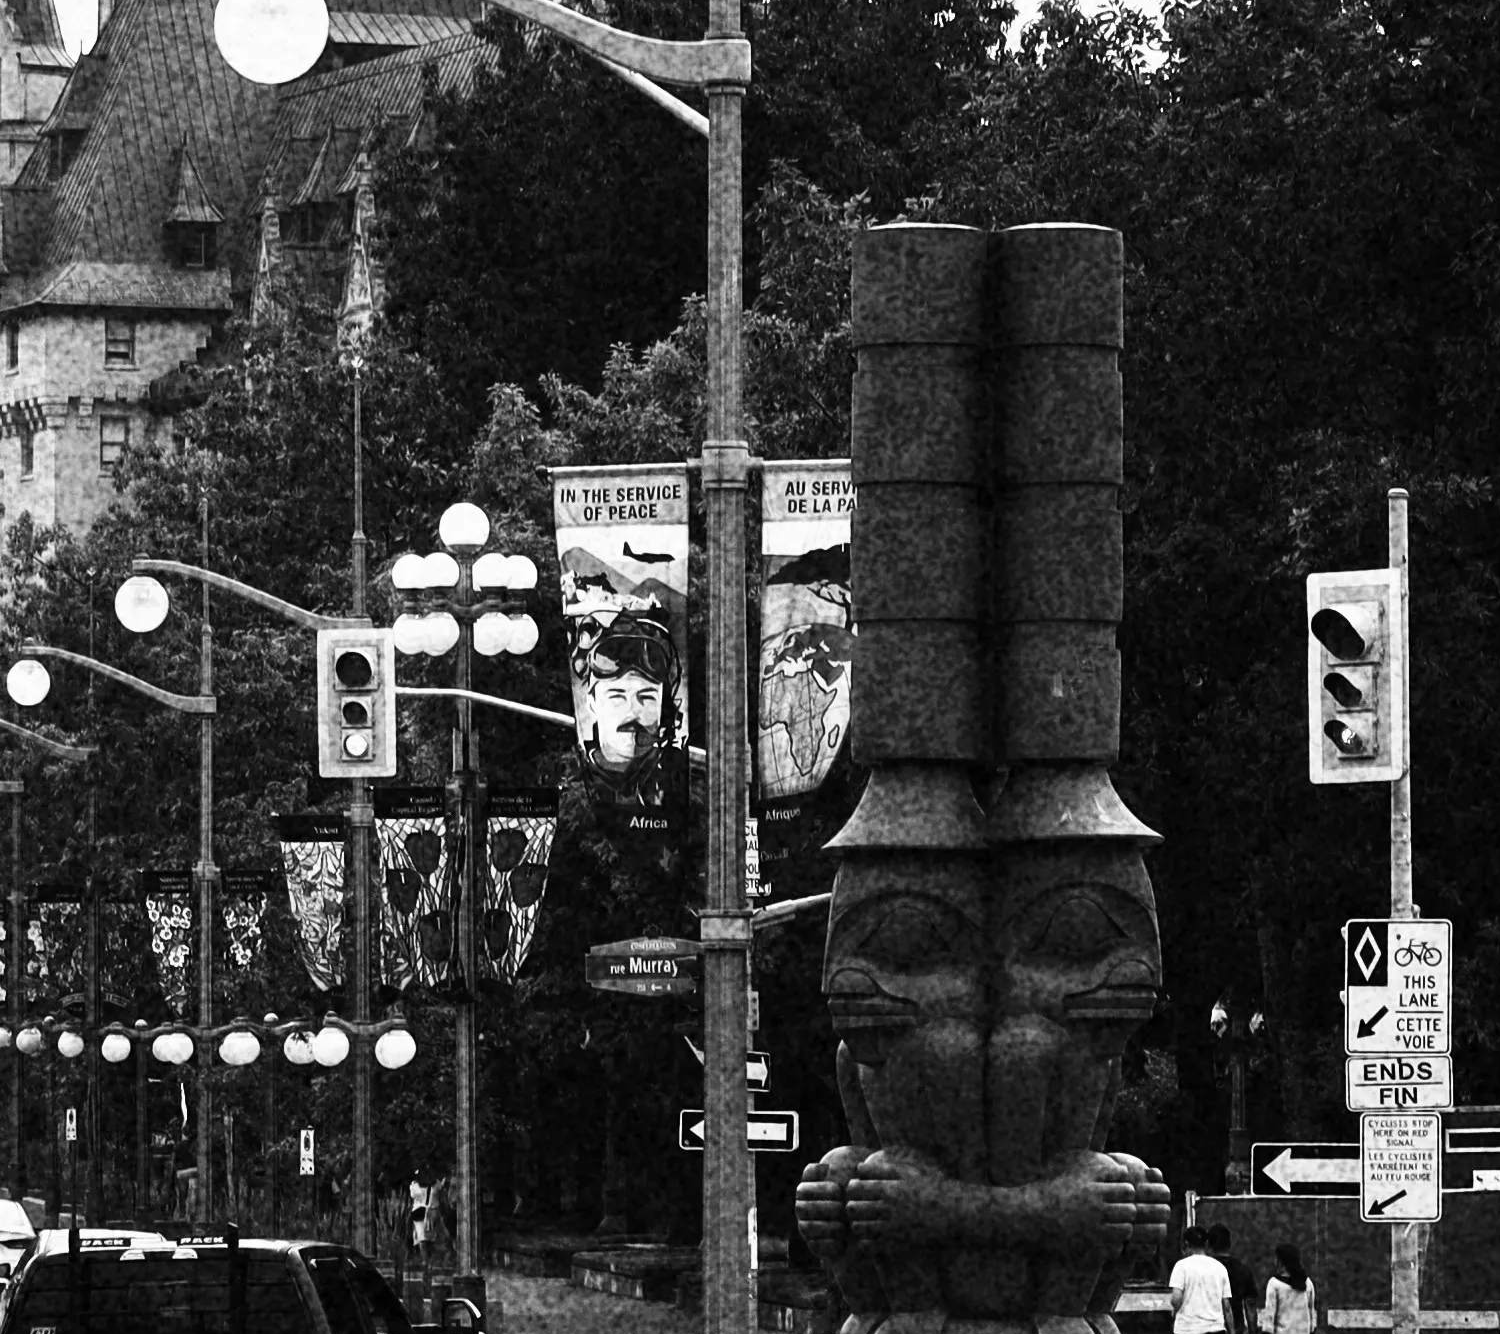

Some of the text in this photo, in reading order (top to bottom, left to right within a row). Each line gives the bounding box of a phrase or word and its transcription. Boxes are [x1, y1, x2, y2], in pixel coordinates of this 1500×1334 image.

[560, 484, 682, 504] IN THE SERVICE
[785, 481, 807, 497] AU
[583, 503, 658, 521] OF PEACE
[787, 498, 808, 514] DE
[813, 497, 832, 513] LA
[765, 808, 801, 822] Afrique
[629, 816, 668, 829] Africa
[610, 956, 678, 978] rue Murray
[1403, 975, 1436, 989] THIS
[1399, 993, 1438, 1007] LANE
[1396, 1018, 1441, 1032] CETTE
[1403, 1035, 1436, 1049] VOIE
[1363, 1061, 1433, 1082] ENDS
[1379, 1086, 1418, 1105] FIN
[1368, 1120, 1433, 1128] CYCLISTS STOP
[1373, 1129, 1429, 1138] HERE ON RED
[1386, 1139, 1414, 1147] SIGNAL
[1368, 1152, 1433, 1161] LES CYCLISTES
[1370, 1173, 1431, 1182] AU FEU ROUGE
